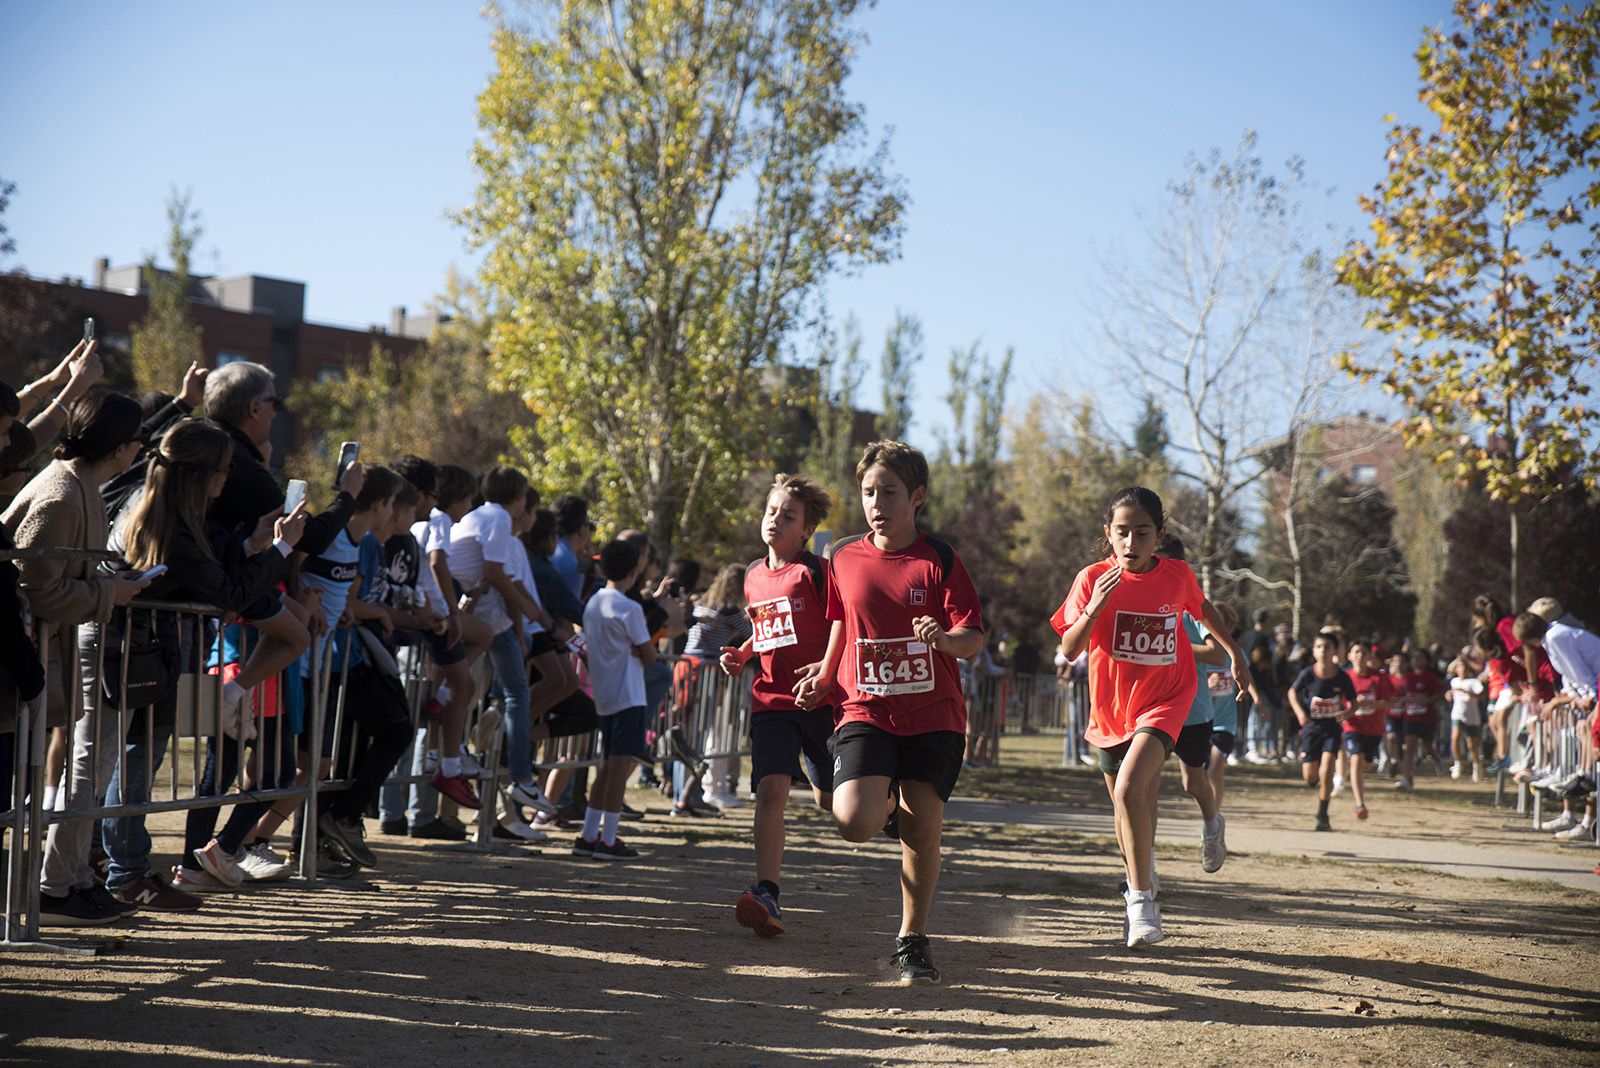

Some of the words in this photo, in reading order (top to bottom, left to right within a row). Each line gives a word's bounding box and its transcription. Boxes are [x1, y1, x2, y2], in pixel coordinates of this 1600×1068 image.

[756, 614, 795, 641] 1644
[1119, 631, 1175, 653] 1046
[864, 658, 929, 683] 1643
